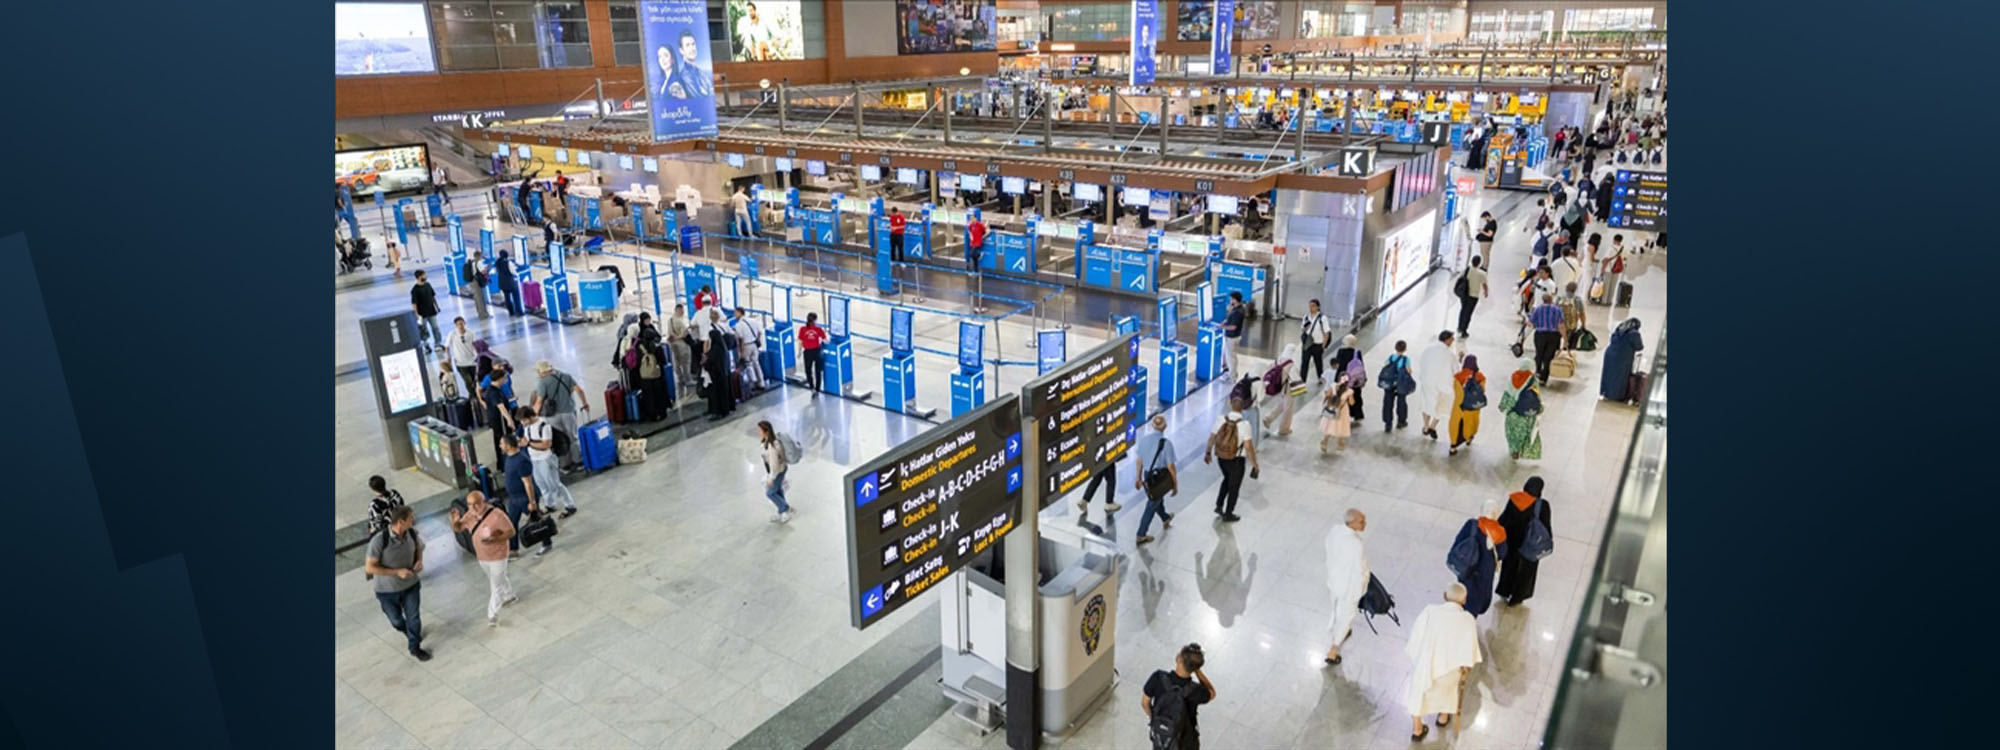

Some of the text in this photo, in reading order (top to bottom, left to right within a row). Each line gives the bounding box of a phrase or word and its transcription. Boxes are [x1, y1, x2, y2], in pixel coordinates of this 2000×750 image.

[471, 113, 484, 128] K
[1430, 124, 1441, 142] J
[1343, 151, 1363, 174] K
[1110, 174, 1125, 184] K02
[1197, 182, 1212, 191] K01
[909, 453, 933, 472] Hatlar
[935, 441, 956, 458] Giden
[957, 430, 976, 446] Yolcu
[901, 444, 977, 491] Domestic Departures
[902, 449, 1005, 513] Check-in A-B-C-D-E-F-G-H
[903, 503, 937, 527] Check-in
[904, 511, 960, 549] Check-in J-K
[973, 539, 988, 554] Lost
[994, 517, 1013, 538] Found
[904, 538, 938, 563] Check-in
[905, 566, 924, 585] Bilet
[905, 565, 950, 598] Ticket Sales
